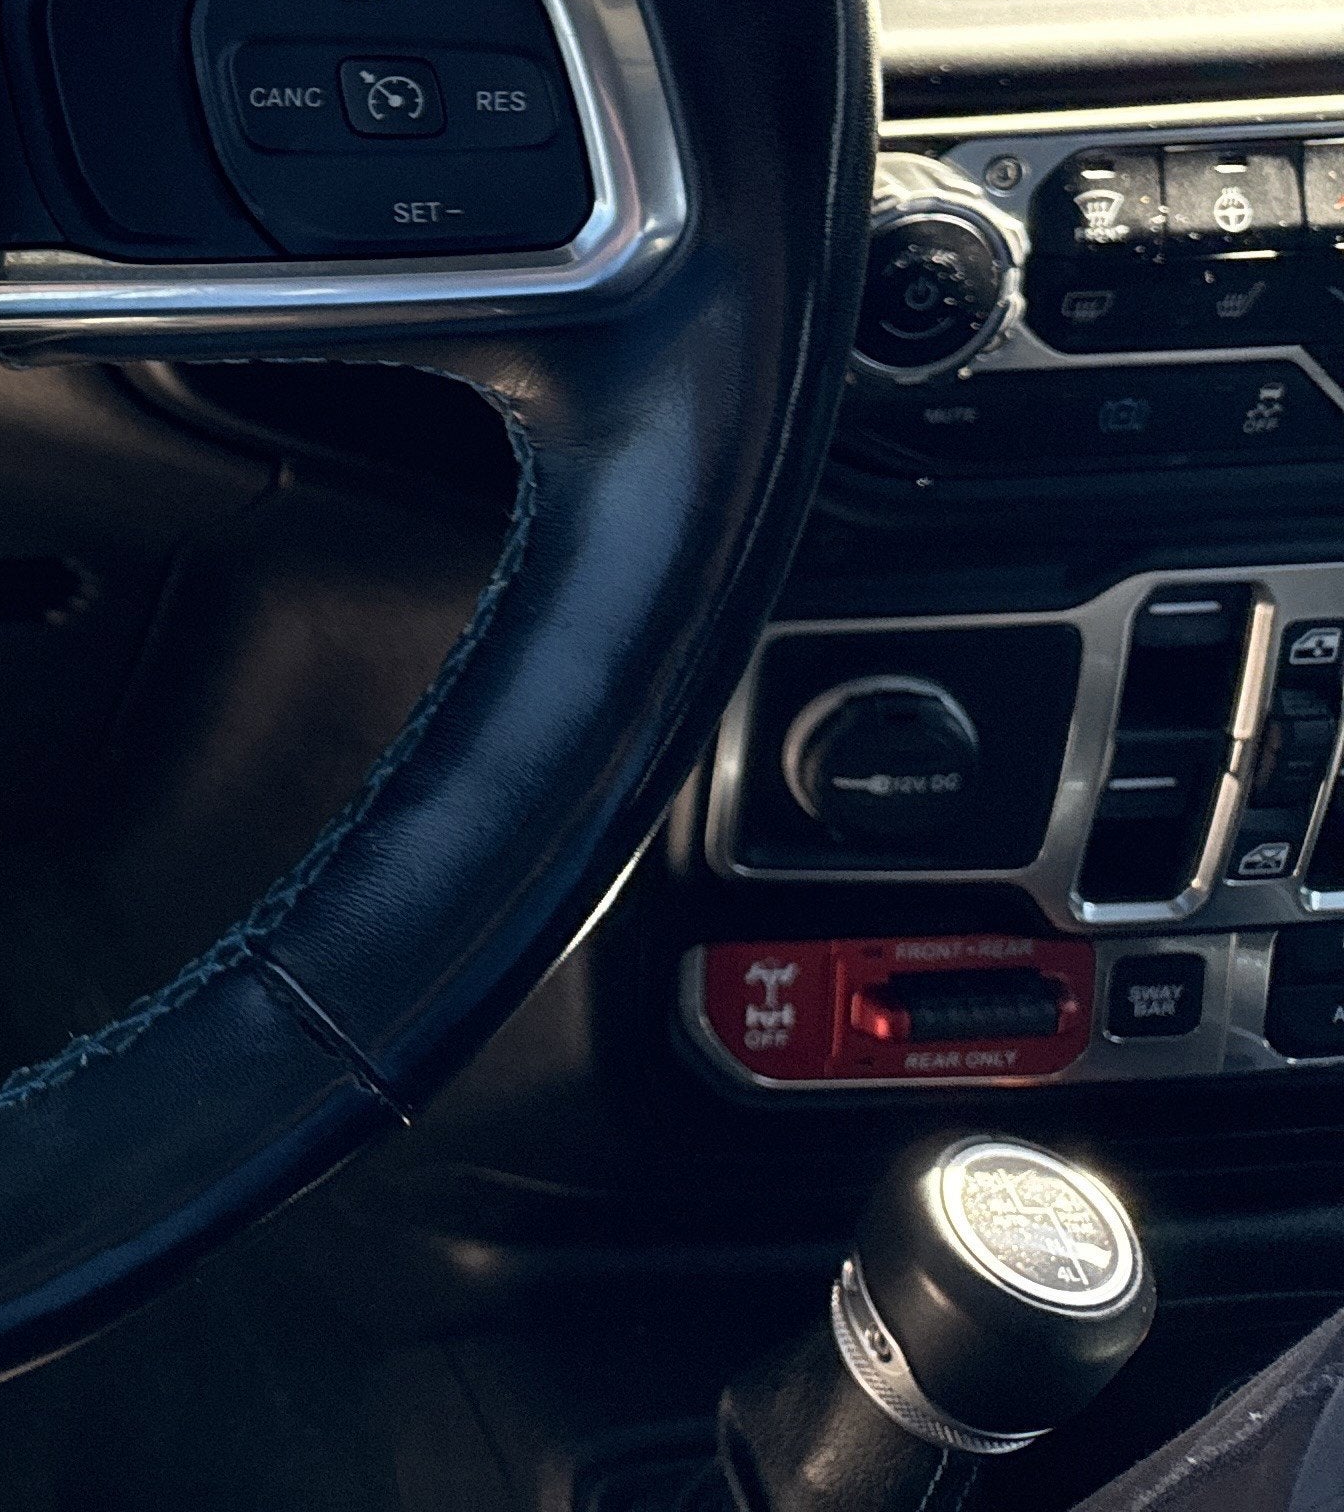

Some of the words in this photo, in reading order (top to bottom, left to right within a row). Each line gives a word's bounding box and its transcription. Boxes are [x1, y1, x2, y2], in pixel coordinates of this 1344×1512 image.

[249, 86, 323, 110] CANC
[475, 90, 527, 113] RES
[904, 1050, 963, 1072] REAR
[963, 1048, 1019, 1071] ONLY
